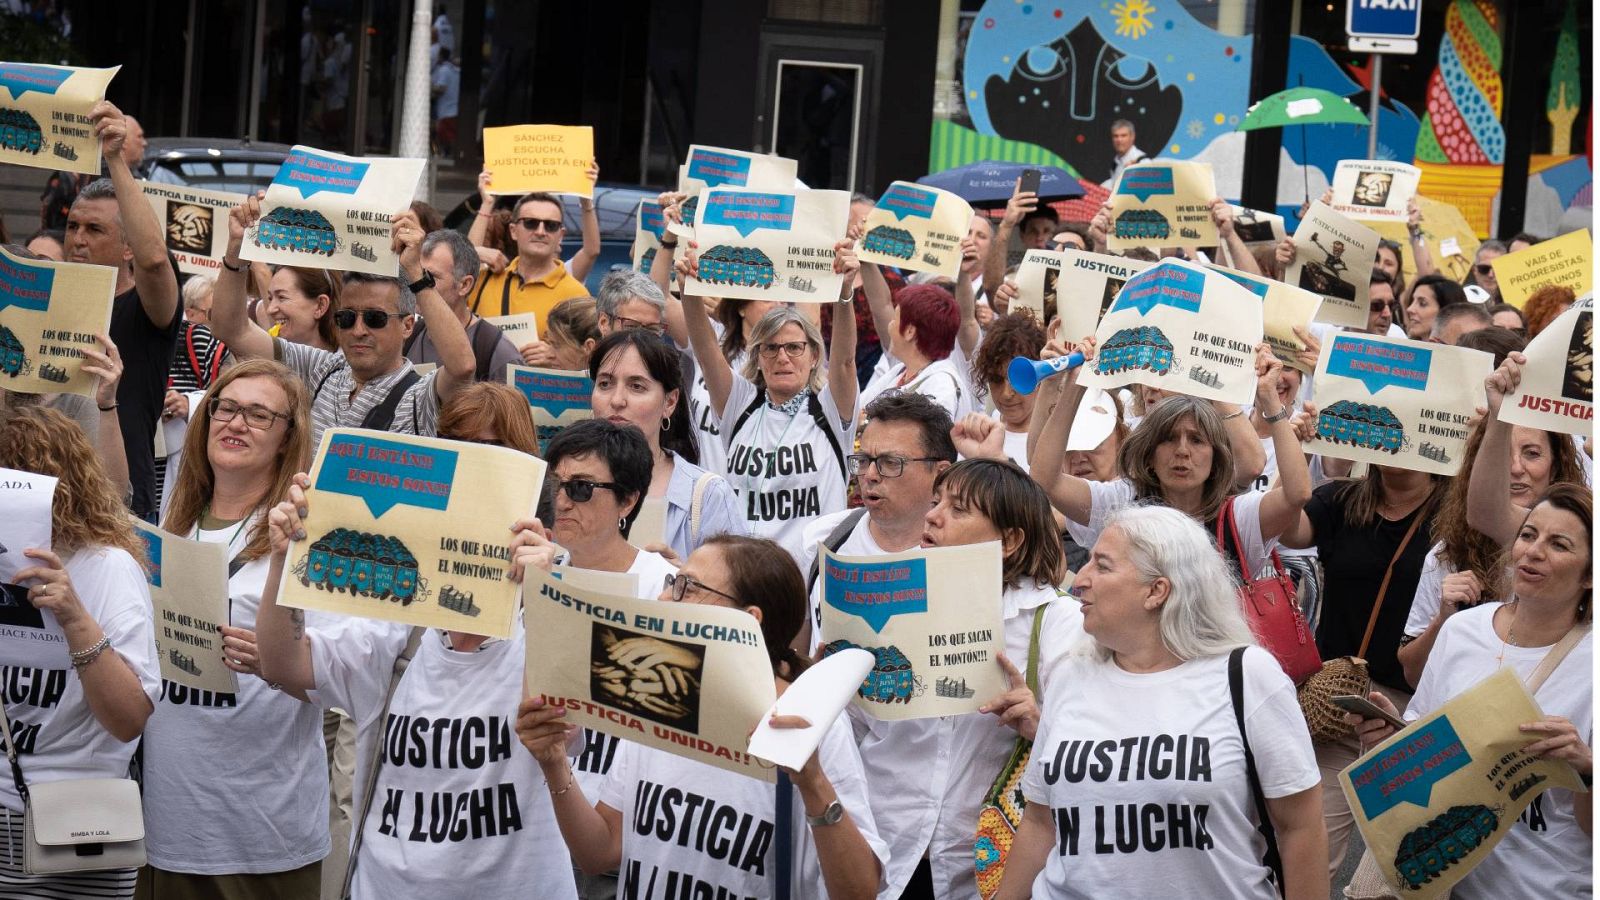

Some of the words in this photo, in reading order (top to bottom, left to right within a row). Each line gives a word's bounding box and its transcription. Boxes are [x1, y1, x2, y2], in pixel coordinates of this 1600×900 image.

[52, 111, 62, 120] LOS
[64, 113, 75, 122] QUE
[52, 125, 59, 134] EL
[514, 146, 565, 154] ESCUCHA
[493, 158, 540, 167] JUSTICIA
[573, 160, 587, 168] EN
[522, 169, 558, 177] LUCHA
[143, 187, 181, 200] JUSTICIA
[184, 194, 196, 203] EN
[347, 209, 359, 219] LOS
[360, 211, 373, 221] QUE
[375, 212, 393, 224] SACA
[347, 224, 354, 234] EL
[1312, 216, 1339, 237] JUSTICIA
[1339, 231, 1365, 251] PARADA
[788, 246, 801, 256] LOS
[802, 247, 815, 257] QUE
[1525, 254, 1548, 268] VAIS
[1549, 249, 1564, 261] DE
[787, 259, 795, 268] EL
[1028, 255, 1061, 268] JUSTICIA
[1074, 258, 1127, 277] JUSTICIA
[1554, 269, 1582, 284] UNOS
[497, 322, 528, 332] CHA!!!
[42, 329, 55, 339] LOS
[57, 331, 72, 341] QUE
[73, 333, 96, 344] SACAN
[1193, 331, 1208, 343] LOS
[1209, 334, 1227, 348] QUE
[1228, 339, 1252, 355] SACAN
[39, 344, 48, 355] EL
[1190, 347, 1201, 357] EL
[1518, 394, 1593, 420] JUSTICIA
[1420, 408, 1434, 419] LOS
[1436, 411, 1451, 422] QUE
[1418, 424, 1428, 434] EL
[747, 486, 820, 522] LUCHA
[440, 537, 459, 552] LOS
[461, 540, 481, 556] QUE
[438, 559, 451, 574] EL
[452, 560, 503, 582] MONTÓN!!!
[162, 609, 176, 622] LOS
[178, 612, 193, 627] QUE
[193, 618, 216, 634] SACAN
[540, 583, 627, 625] JUSTICIA
[634, 613, 664, 633] EN
[672, 620, 758, 647] LUCHA!!!
[164, 627, 174, 638] EL
[929, 634, 947, 647] LOS
[949, 632, 966, 646] QUE
[967, 629, 992, 643] SACAN
[929, 655, 941, 667] EL
[943, 649, 988, 666] MONTÓN!!!
[540, 693, 645, 733] JUSTICIA
[1043, 734, 1212, 785] JUSTICIA
[1486, 763, 1502, 782] LOS
[1495, 779, 1506, 792] EL
[408, 782, 523, 844] LUCHA
[1051, 806, 1080, 857] N
[1095, 802, 1215, 855] LUCHA
